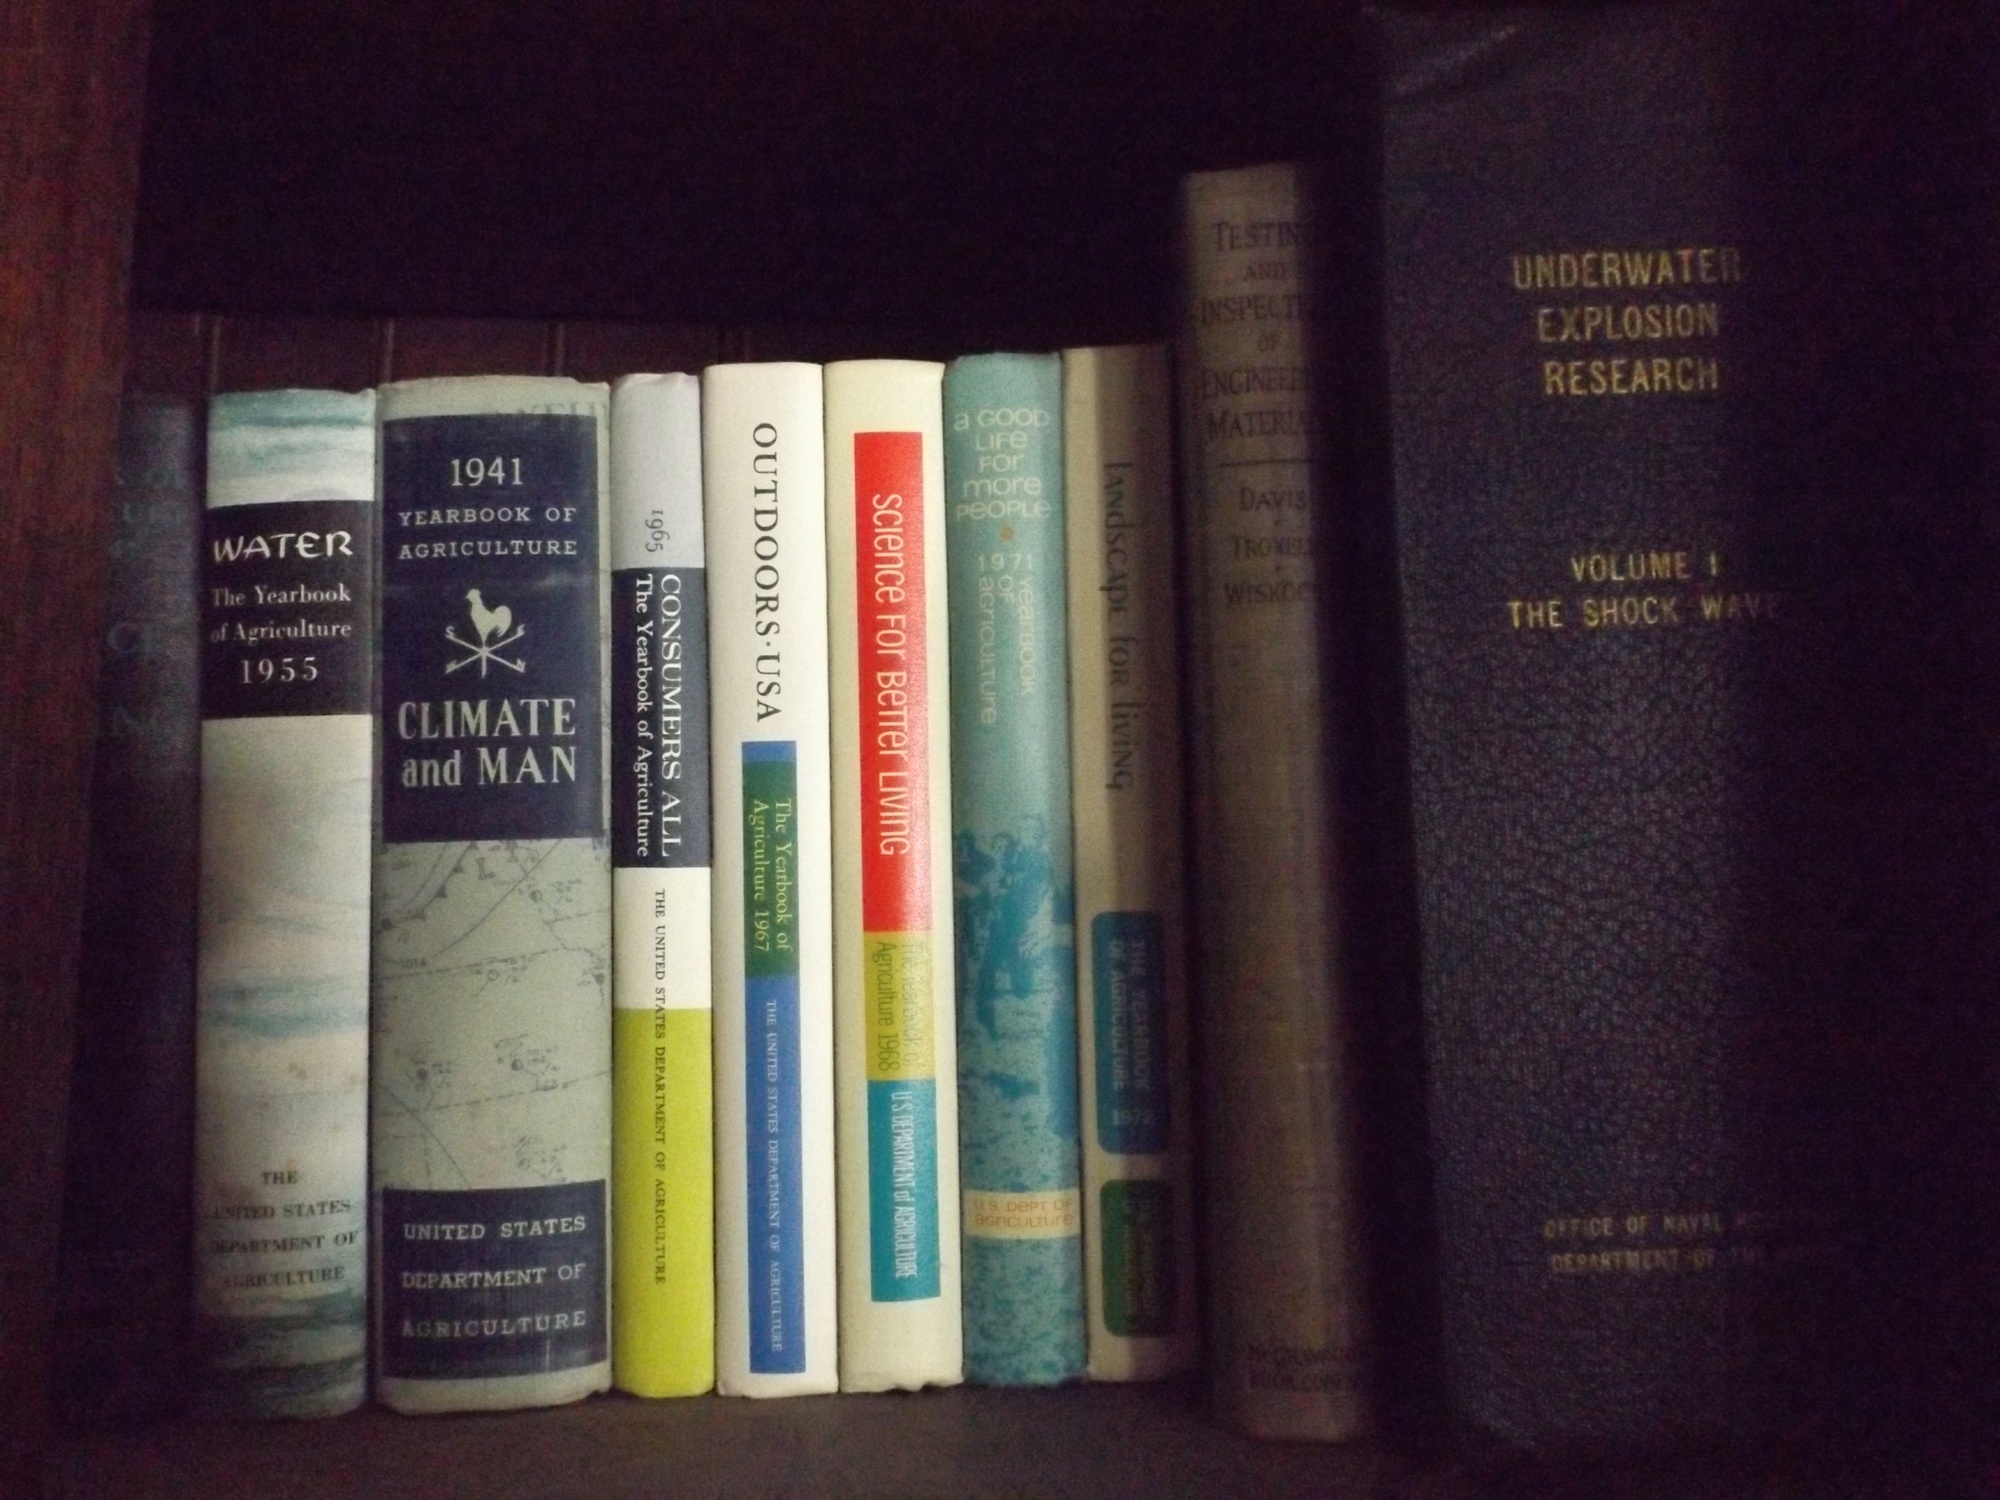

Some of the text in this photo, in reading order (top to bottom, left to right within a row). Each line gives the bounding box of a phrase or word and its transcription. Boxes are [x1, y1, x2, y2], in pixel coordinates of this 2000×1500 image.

[1243, 261, 1288, 281] AND
[1511, 247, 1742, 290] UNDERWATER
[1538, 303, 1721, 343] EXPLOSION
[1543, 357, 1720, 396] RESEARCH
[954, 408, 1049, 431] a GOOD
[451, 457, 523, 486] 1941
[963, 477, 1042, 498] more
[1239, 486, 1307, 512] DAVIS
[398, 507, 576, 527] YEARBOOK OF
[645, 509, 670, 553] 1965
[212, 531, 353, 562] WATER
[398, 540, 577, 559] AGRICULTURE
[978, 553, 1033, 572] 1971
[1570, 551, 1691, 583] VOLUME
[212, 583, 351, 608] The Yearbook
[1507, 599, 1564, 629] THE
[1582, 596, 1680, 627] SHOCK
[210, 623, 228, 642] of
[233, 619, 351, 641] Agriculture
[242, 657, 319, 684] 1955
[398, 699, 576, 740] CLIMATE
[633, 573, 653, 857] The Yearbook of Agriculture
[660, 574, 683, 857] CONSUMERS ALL
[402, 747, 577, 787] and MAN
[749, 800, 770, 951] Agriculture 1967
[775, 798, 793, 952] The Yearbook of
[871, 941, 900, 1072] Agriculture 1968
[655, 889, 666, 1285] THE UNITED STATES DEPARTMENT OF AGRICULTURE
[892, 1115, 915, 1188] DEPARTMENT
[261, 1171, 298, 1186] THE
[767, 1000, 782, 1352] THE UNITED STATES DEPARTMENT OF AGRICULTURE
[211, 1200, 352, 1221] UNITED STATES
[894, 1189, 916, 1203] of
[404, 1216, 587, 1241] UNITED STATES
[1625, 1213, 1649, 1236] OF
[210, 1231, 359, 1254] DEPARTMENT OF
[895, 1207, 917, 1279] AGRICULTURE
[403, 1263, 587, 1290] DEPARTMENT OF
[403, 1310, 587, 1339] AGRICULTURE
